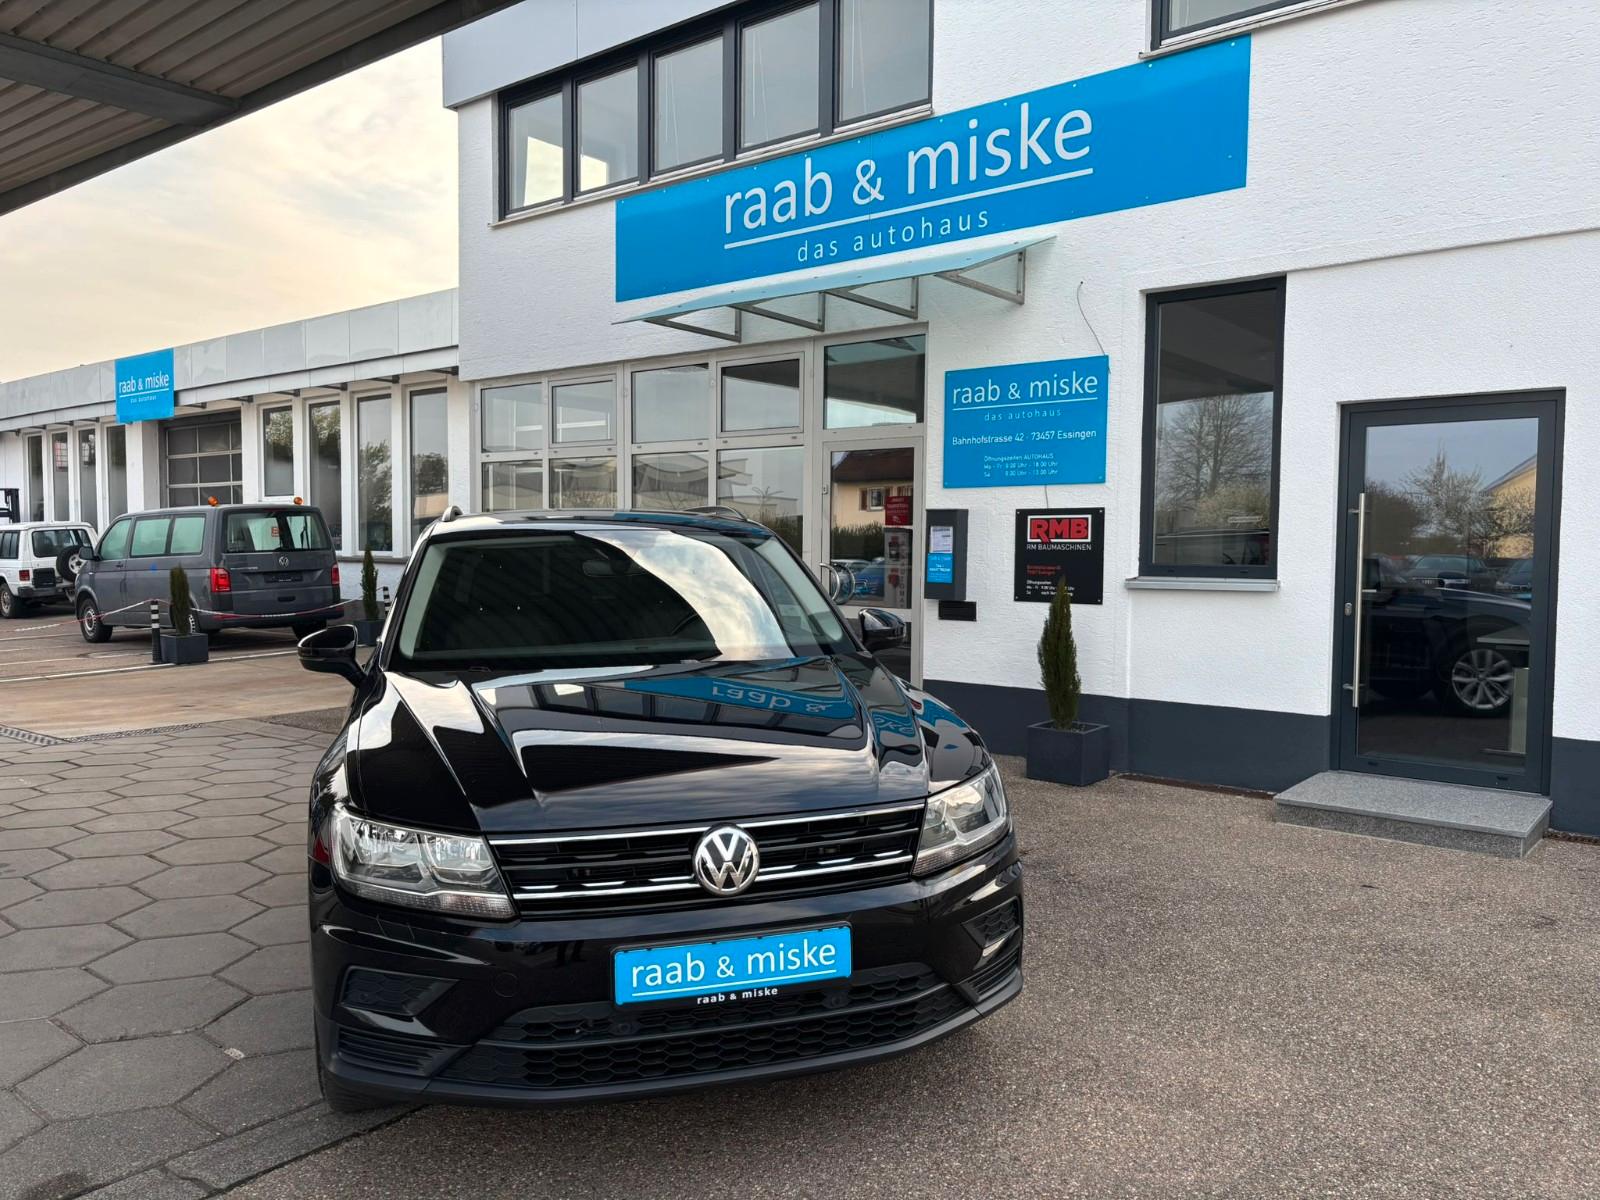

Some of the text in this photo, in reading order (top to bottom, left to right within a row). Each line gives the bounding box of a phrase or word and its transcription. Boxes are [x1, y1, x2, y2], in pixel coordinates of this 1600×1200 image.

[725, 102, 1093, 234] raab & miske
[798, 209, 989, 262] das autohaus
[119, 370, 169, 393] raab & miske
[953, 370, 1098, 405] raab & miske
[984, 408, 1062, 421] das autohaus
[952, 430, 1097, 446] Bahnhofstrasse 42 73457 Essingen
[1030, 517, 1088, 543] RMB
[632, 938, 836, 988] raab & miske
[696, 986, 779, 1005] raab & miske
